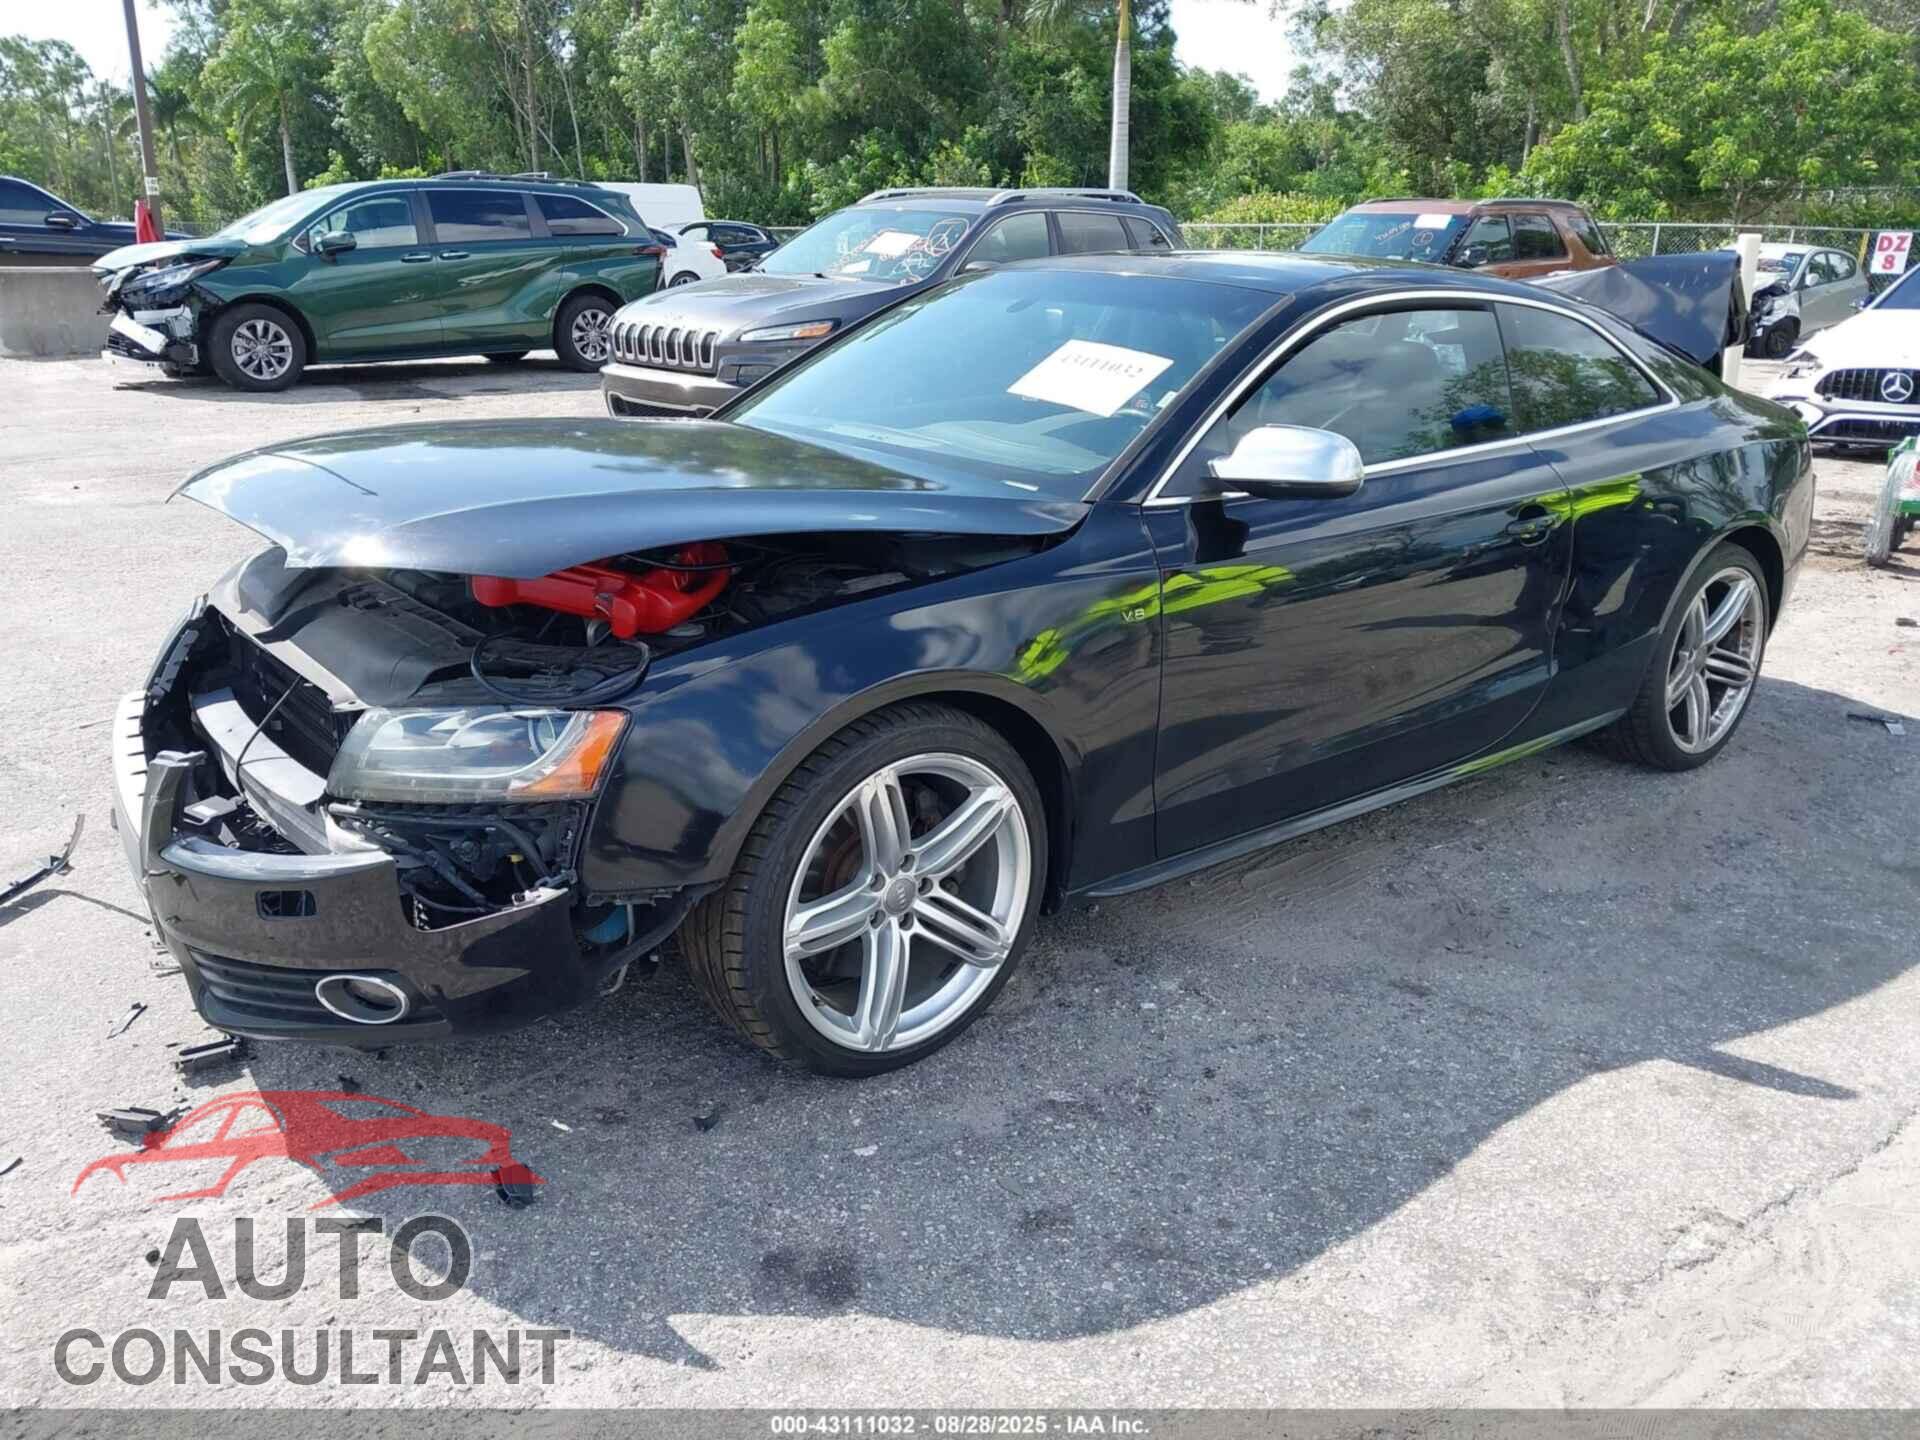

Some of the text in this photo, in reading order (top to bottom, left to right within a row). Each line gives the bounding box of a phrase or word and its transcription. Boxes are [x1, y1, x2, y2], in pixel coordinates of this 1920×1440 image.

[1878, 235, 1908, 252] DZ
[1882, 254, 1896, 270] 8
[1122, 608, 1145, 622] V8
